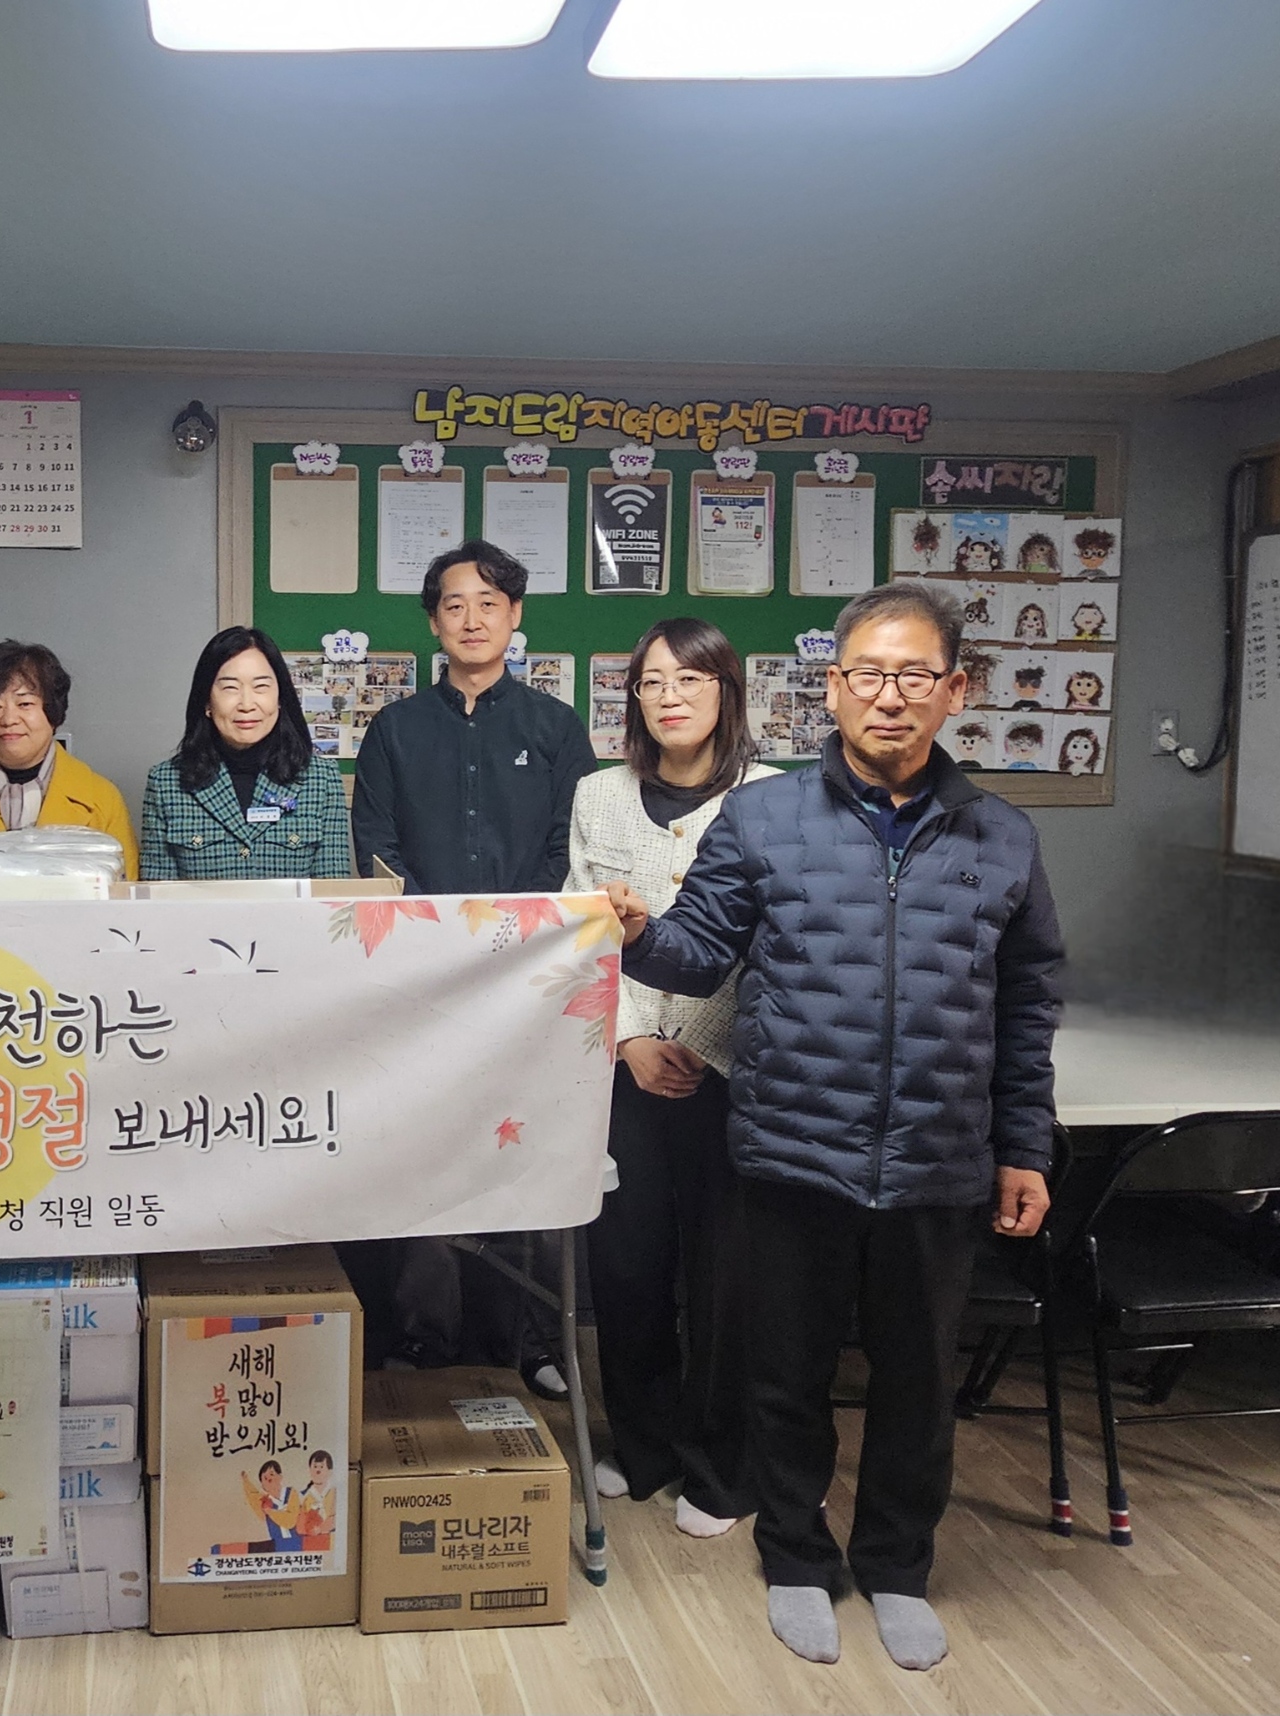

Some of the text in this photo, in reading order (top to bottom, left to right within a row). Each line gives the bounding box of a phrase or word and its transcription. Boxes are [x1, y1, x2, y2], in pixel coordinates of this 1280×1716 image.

[24, 410, 32, 424] 1
[809, 403, 929, 444] 게시판
[51, 463, 61, 471] 10
[64, 463, 74, 471] 11
[299, 453, 331, 465] NEWS
[10, 504, 20, 512] 21
[24, 504, 34, 512] 22
[38, 504, 47, 512] 23
[51, 504, 61, 512] 24
[65, 504, 74, 512] 25
[627, 529, 659, 540] ZONE
[108, 1090, 339, 1153] 보내세요!
[39, 1195, 93, 1230] 직원
[108, 1193, 166, 1229] 일동
[228, 1343, 275, 1380] 새해
[206, 1381, 283, 1418] 복 많이
[206, 1419, 308, 1458] 받으세요!
[441, 1515, 532, 1541] 모나리자
[441, 1541, 531, 1561] 내추럴 소프트
[215, 1555, 322, 1569] 경상남도창녕교육지원청
[260, 1567, 278, 1575] OFFICE
[291, 1566, 321, 1574] EDUCATION
[442, 1563, 477, 1572] NATURAL
[485, 1562, 505, 1570] SOFT
[507, 1560, 531, 1568] WIPES
